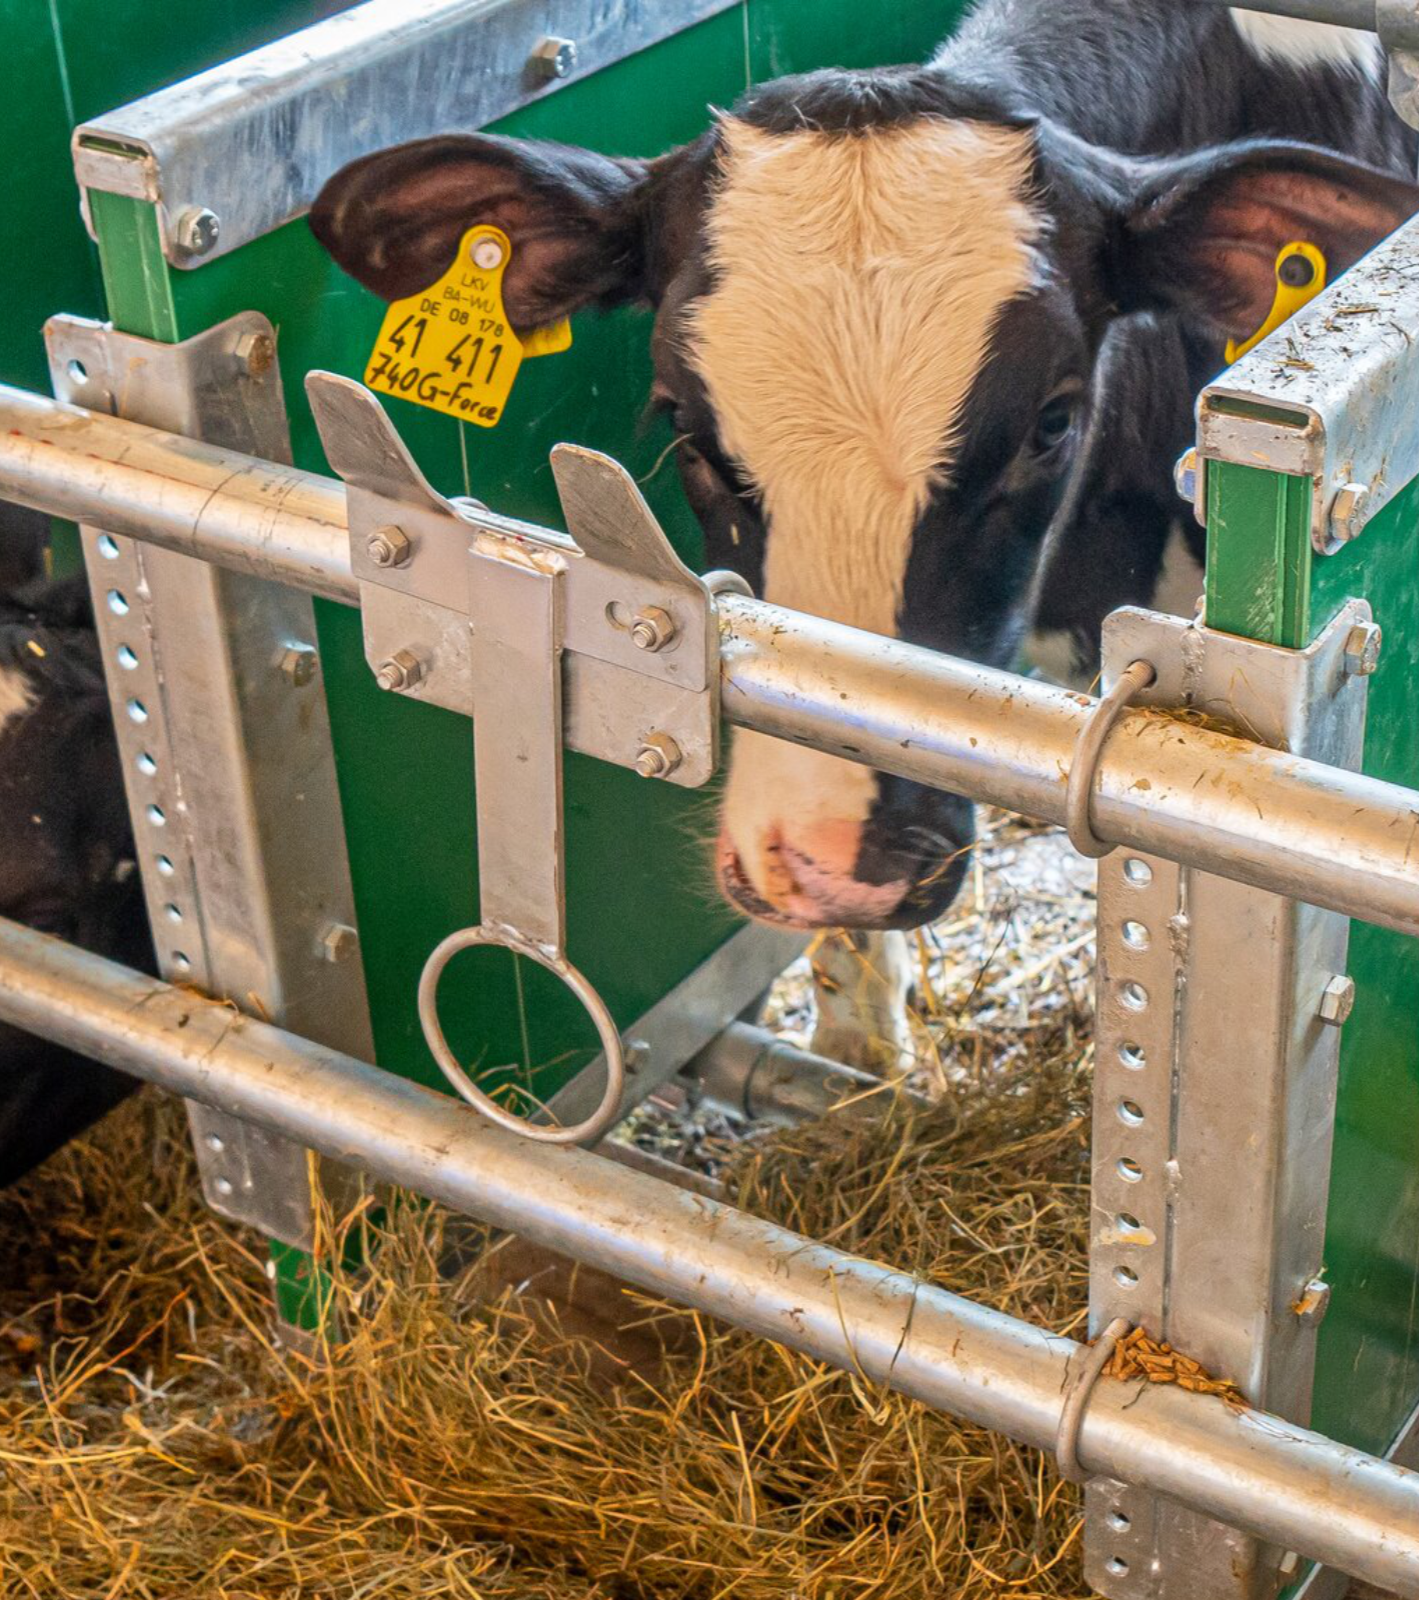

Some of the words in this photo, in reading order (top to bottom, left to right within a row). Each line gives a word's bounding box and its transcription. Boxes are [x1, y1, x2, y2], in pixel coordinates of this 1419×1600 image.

[461, 273, 489, 291] LKV
[443, 286, 495, 314] BA-WU
[420, 298, 441, 316] DE
[449, 308, 469, 325] 08
[479, 319, 504, 337] 178
[388, 314, 428, 358] 41
[445, 333, 503, 385] 411
